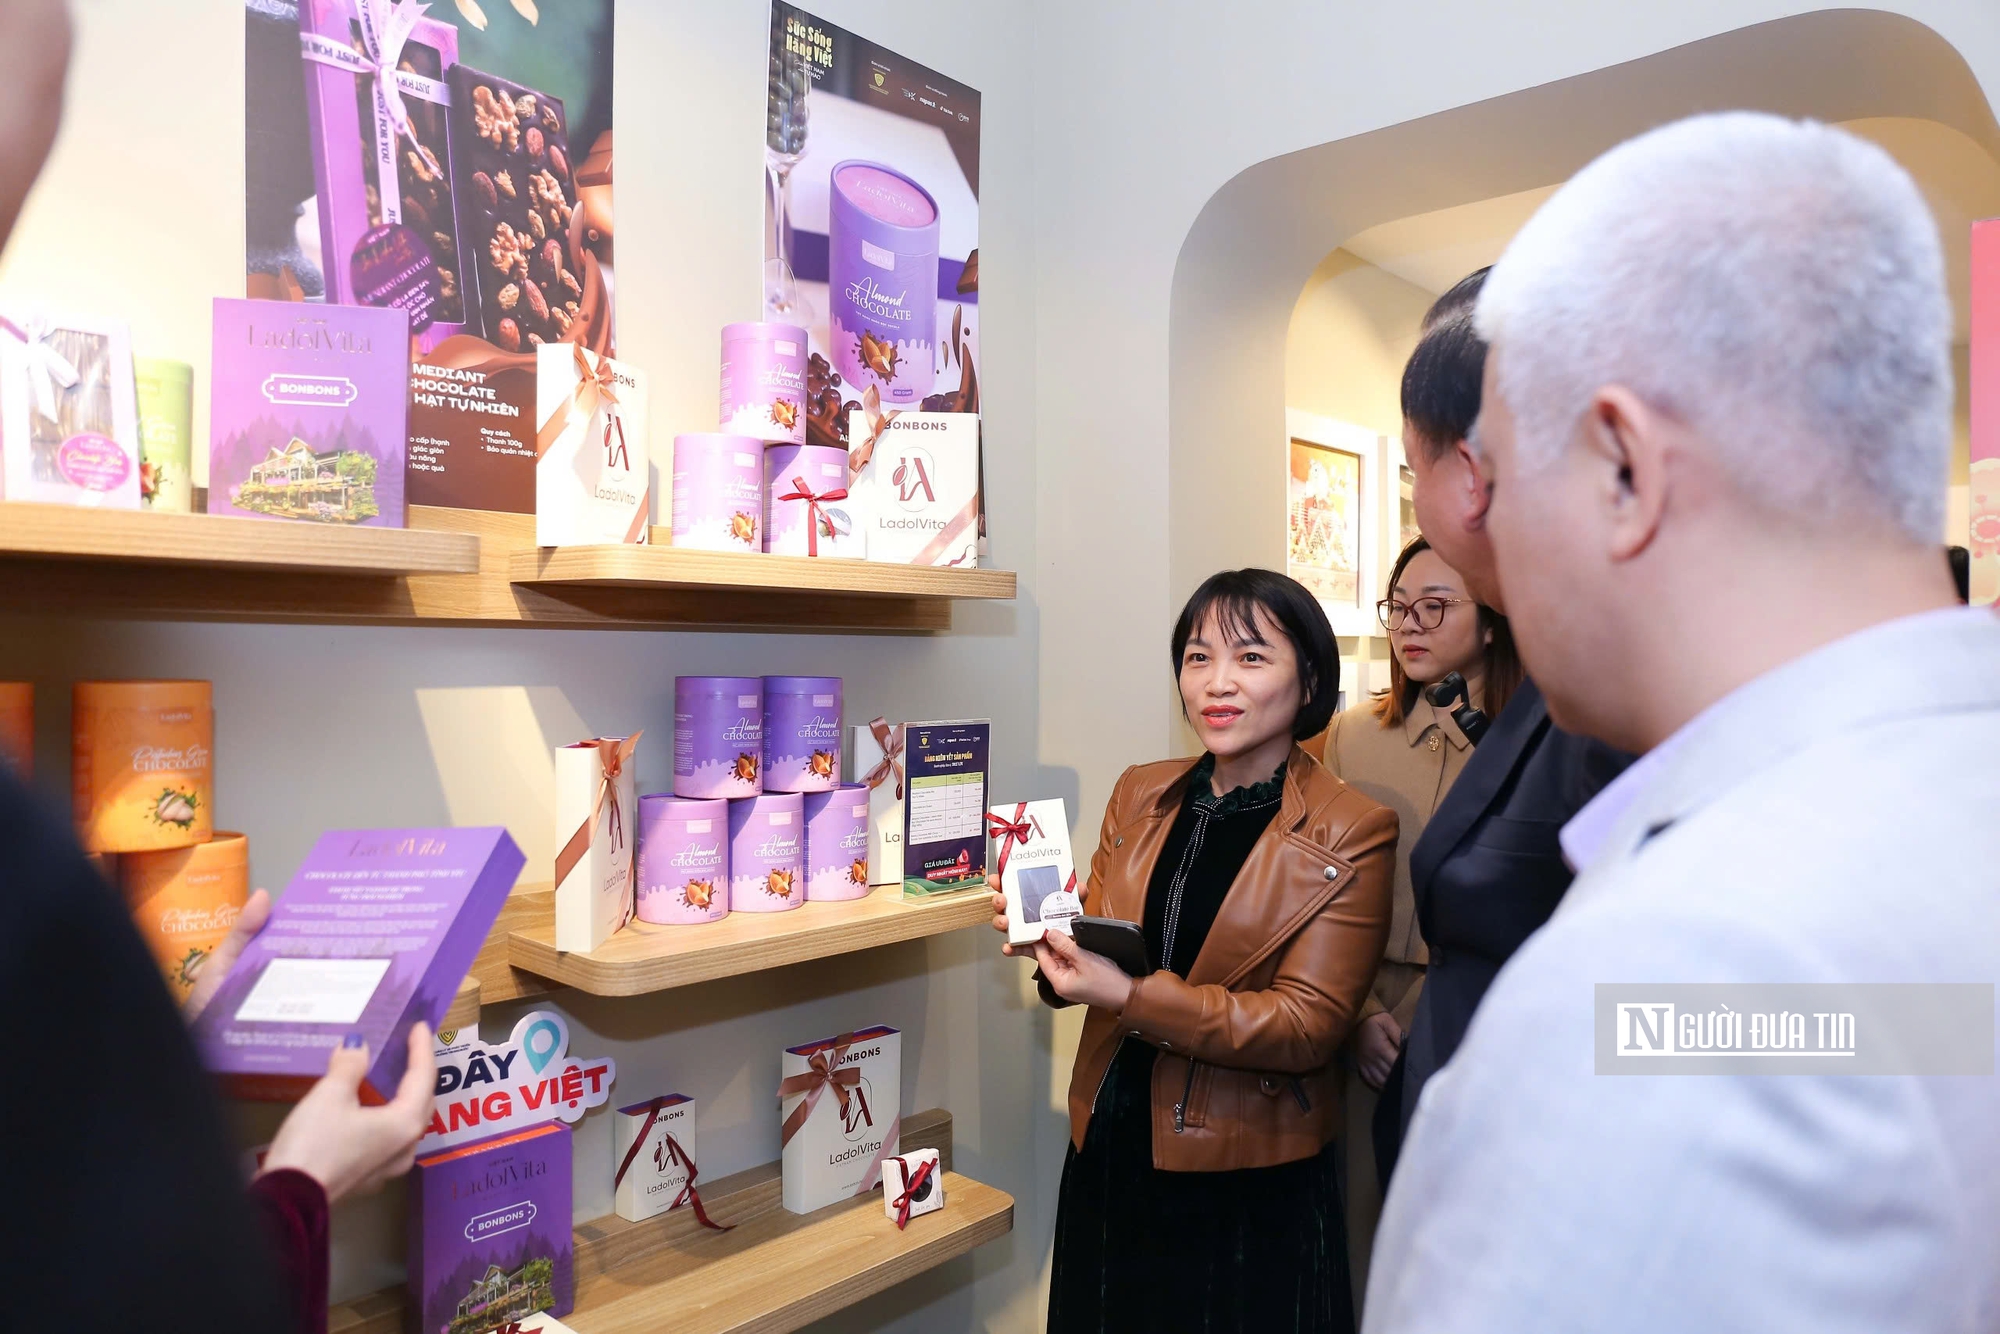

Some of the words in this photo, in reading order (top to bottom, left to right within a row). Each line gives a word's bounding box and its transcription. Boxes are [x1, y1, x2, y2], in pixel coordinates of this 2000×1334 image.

[786, 17, 806, 38] Sức
[808, 26, 832, 52] Sống
[786, 34, 812, 62] Hàng
[814, 45, 832, 68] Việt
[415, 80, 430, 94] JUST
[378, 90, 386, 116] JUST
[380, 116, 388, 139] FOR
[382, 141, 390, 165] YOU
[850, 276, 906, 308] Almond
[846, 288, 912, 320] CHOCOLATE
[249, 324, 372, 354] LadolVita
[412, 363, 486, 384] MEDIANT
[614, 372, 636, 388] BONS
[764, 362, 803, 380] Almond
[280, 383, 341, 396] BONBONS
[414, 392, 446, 408] HẠT
[448, 398, 470, 412] TỰ
[470, 400, 519, 417] NHIÊN
[480, 427, 494, 437] Quy
[495, 429, 511, 438] cách
[884, 421, 948, 431] BONBONS
[413, 445, 428, 453] giác
[416, 437, 430, 445] cấp
[486, 437, 507, 446] Thanh
[507, 439, 522, 448] 100g
[486, 445, 500, 453] Bảo
[501, 447, 517, 456] quản
[518, 450, 534, 458] nhiệt
[412, 462, 430, 471] hoặc
[594, 484, 636, 505] LadolVita
[879, 518, 947, 530] LadolVita
[727, 716, 762, 736] Almond
[798, 729, 840, 738] CHOCOLATE
[803, 715, 838, 736] Almond
[133, 757, 207, 772] CHOCOLATE
[758, 834, 798, 852] Almond
[885, 832, 900, 843] La
[676, 842, 720, 862] Almond
[754, 846, 800, 857] CHOCOLATE
[1010, 848, 1062, 860] LadolVita
[670, 856, 722, 867] CHOCOLATE
[924, 860, 936, 868] GIÁ
[604, 868, 626, 892] LadolVita
[839, 1046, 881, 1065] ONBONS
[435, 1050, 518, 1096] ĐÂY
[424, 1091, 512, 1136] ANG
[518, 1064, 608, 1111] VIỆT
[653, 1110, 685, 1124] ONBONS
[829, 1141, 882, 1165] LadolVita
[452, 1160, 546, 1200] LadolVita
[647, 1176, 686, 1195] LadolVita
[478, 1210, 524, 1231] BONBONS
